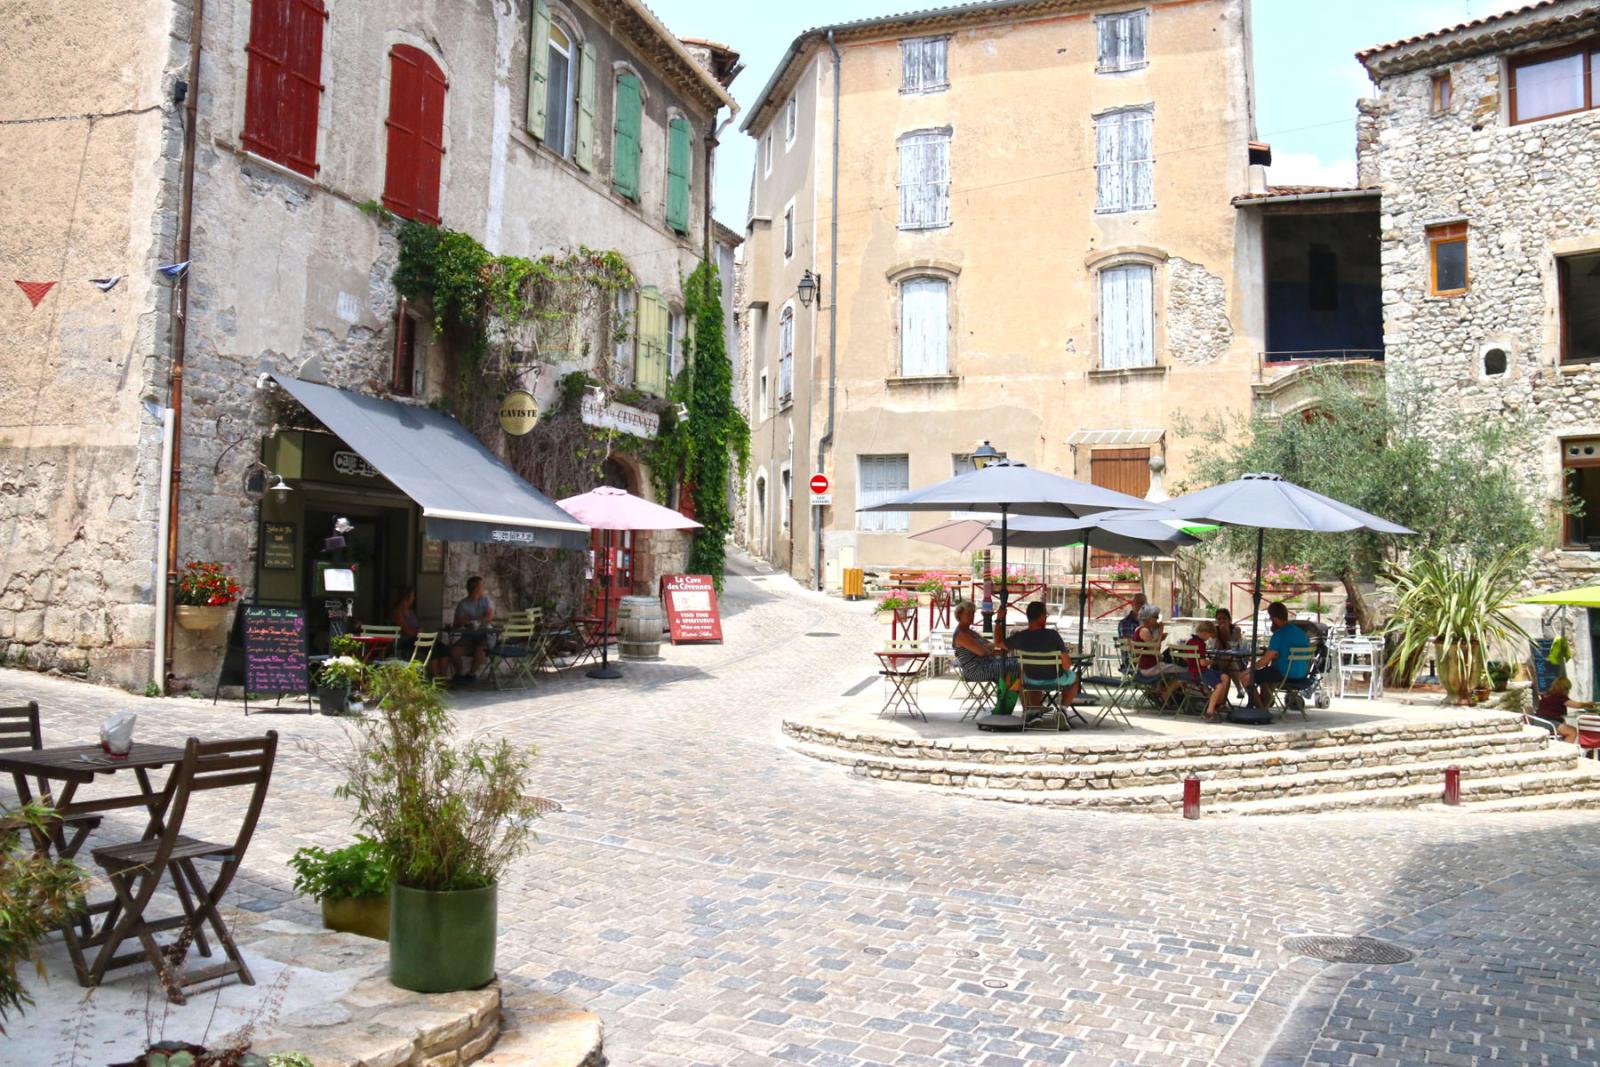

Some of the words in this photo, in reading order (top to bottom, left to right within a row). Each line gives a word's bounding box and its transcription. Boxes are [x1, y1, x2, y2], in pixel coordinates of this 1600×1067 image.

[500, 409, 537, 417] CAVISTE
[667, 582, 679, 590] des
[679, 582, 711, 590] Cévennes
